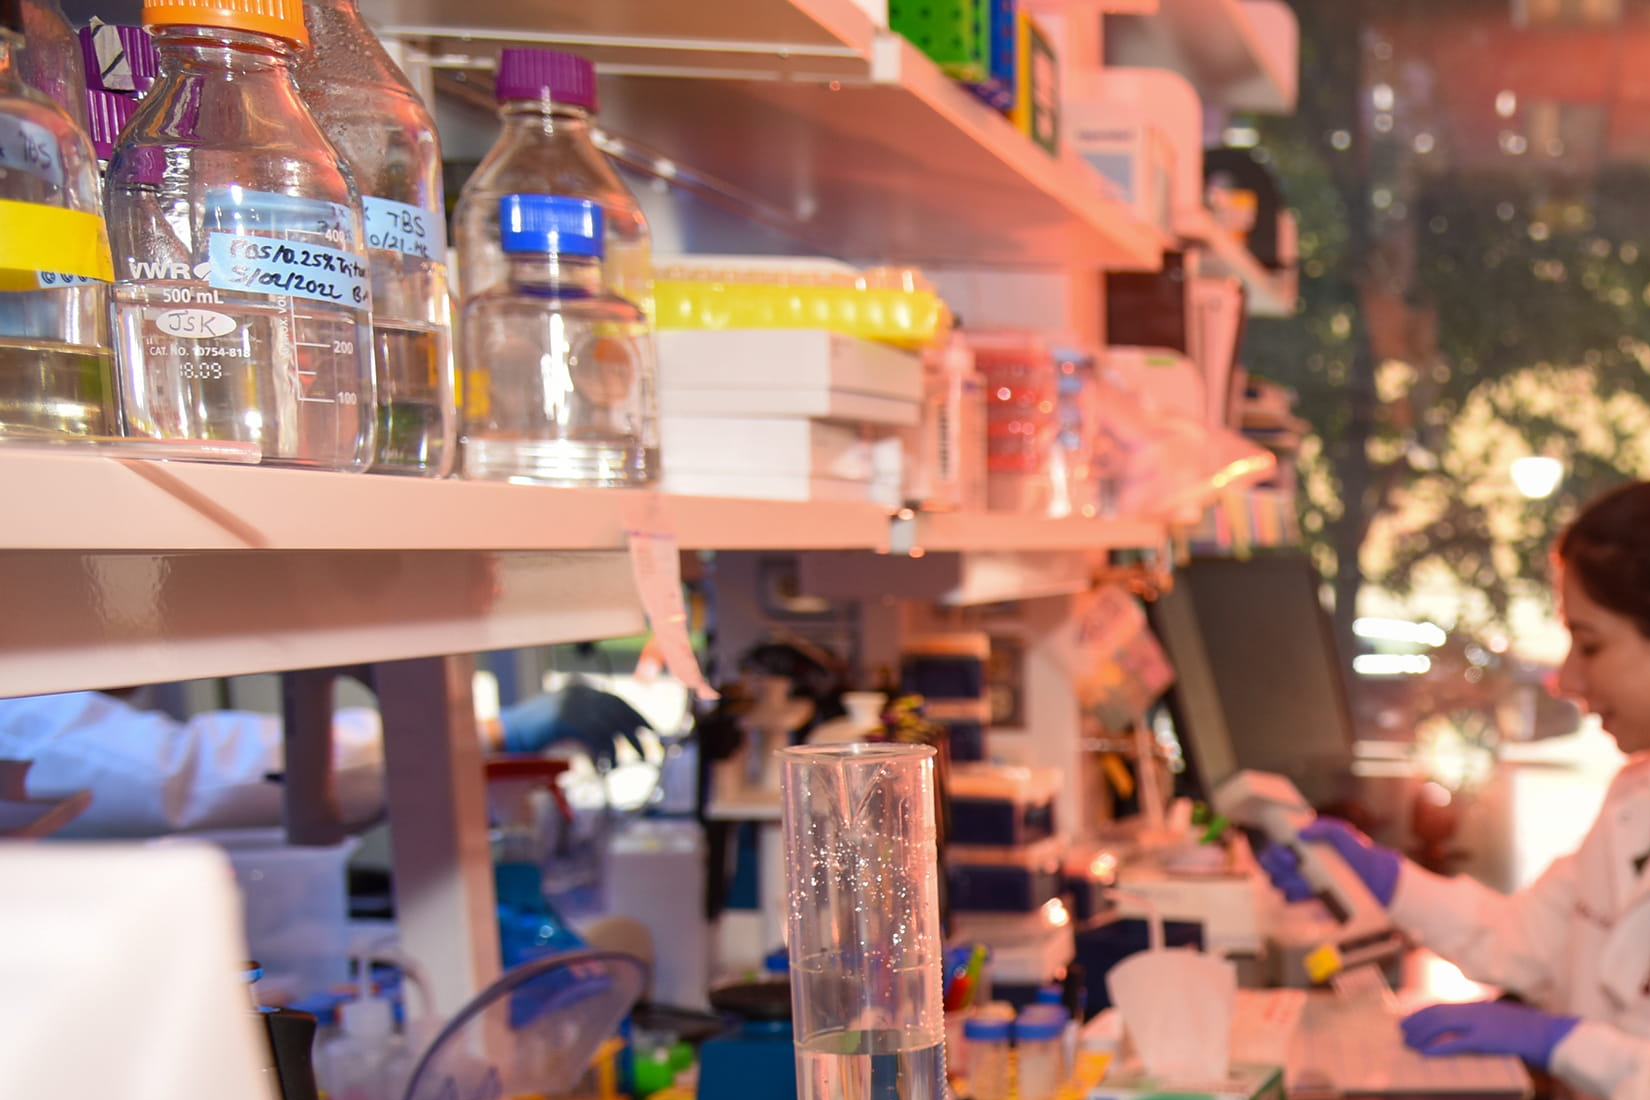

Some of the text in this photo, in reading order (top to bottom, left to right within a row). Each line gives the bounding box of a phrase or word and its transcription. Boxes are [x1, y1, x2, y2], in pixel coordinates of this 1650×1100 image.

[386, 209, 426, 238] TBS
[128, 262, 192, 280] VWR
[163, 288, 225, 305] 500 mL
[167, 310, 217, 337] JSK
[149, 346, 168, 357] CAT.
[333, 340, 354, 355] 200
[338, 391, 358, 406] 100
